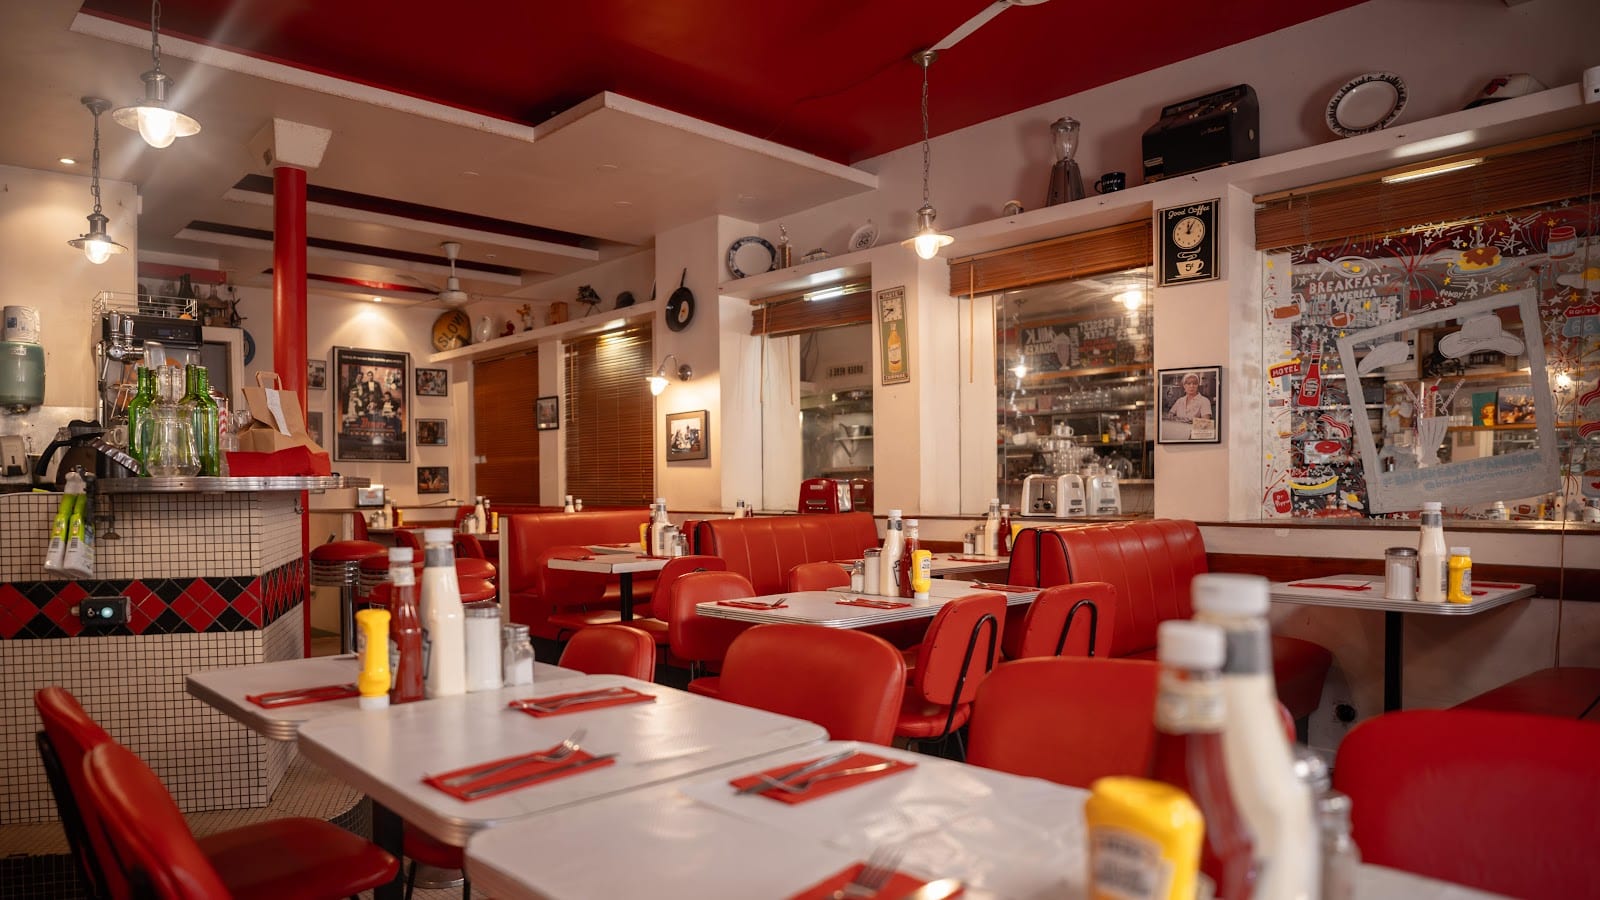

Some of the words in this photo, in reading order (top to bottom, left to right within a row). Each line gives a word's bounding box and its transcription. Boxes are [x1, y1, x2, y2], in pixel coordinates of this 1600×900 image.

[1168, 209, 1186, 219] Good
[1187, 205, 1210, 216] Coffee
[1309, 273, 1391, 295] BREAKFAST
[1329, 288, 1377, 302] AMERICA
[438, 312, 466, 348] SLOW
[1571, 319, 1593, 332] 66
[1271, 364, 1299, 378] MOTEL
